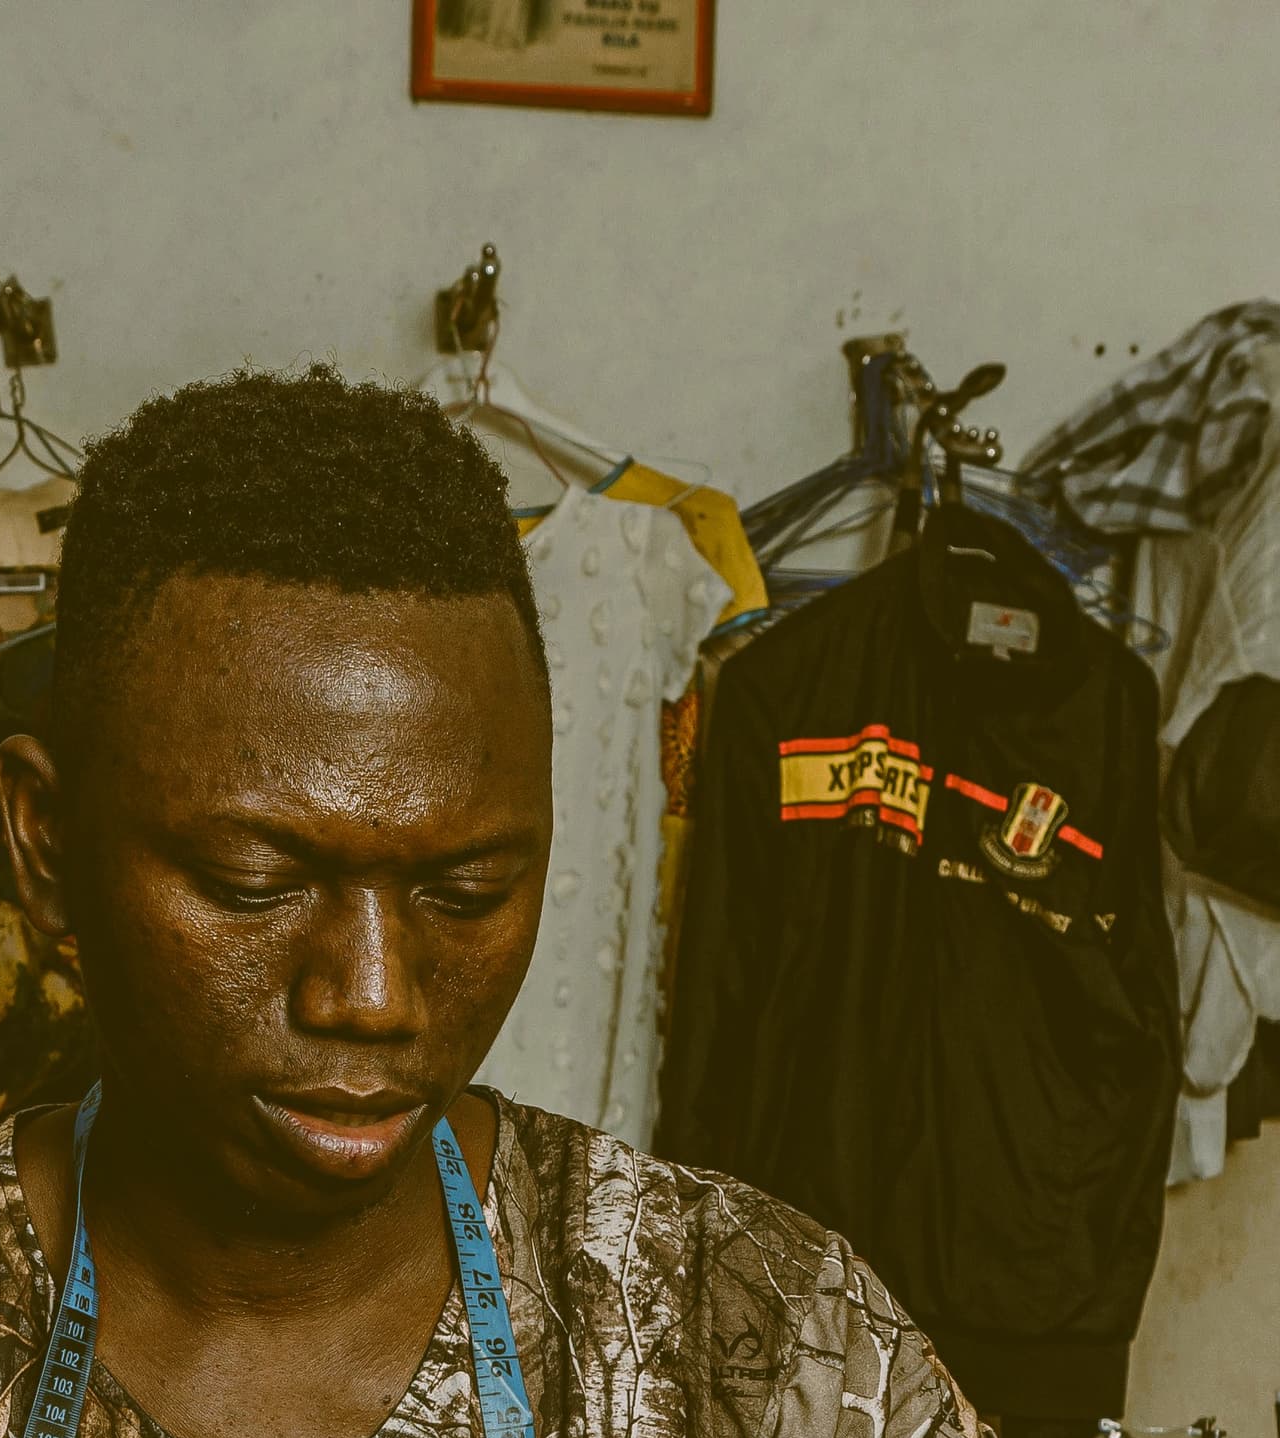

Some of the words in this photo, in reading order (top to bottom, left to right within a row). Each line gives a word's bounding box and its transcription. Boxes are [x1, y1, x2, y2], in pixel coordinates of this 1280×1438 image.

[440, 1139, 463, 1177] 29
[458, 1203, 483, 1241] 28
[473, 1270, 498, 1310] 27
[75, 1293, 90, 1312] 100
[68, 1320, 85, 1340] 101
[60, 1347, 80, 1369] 102
[486, 1337, 512, 1378] 26
[53, 1375, 74, 1396] 103
[45, 1404, 66, 1424] 104
